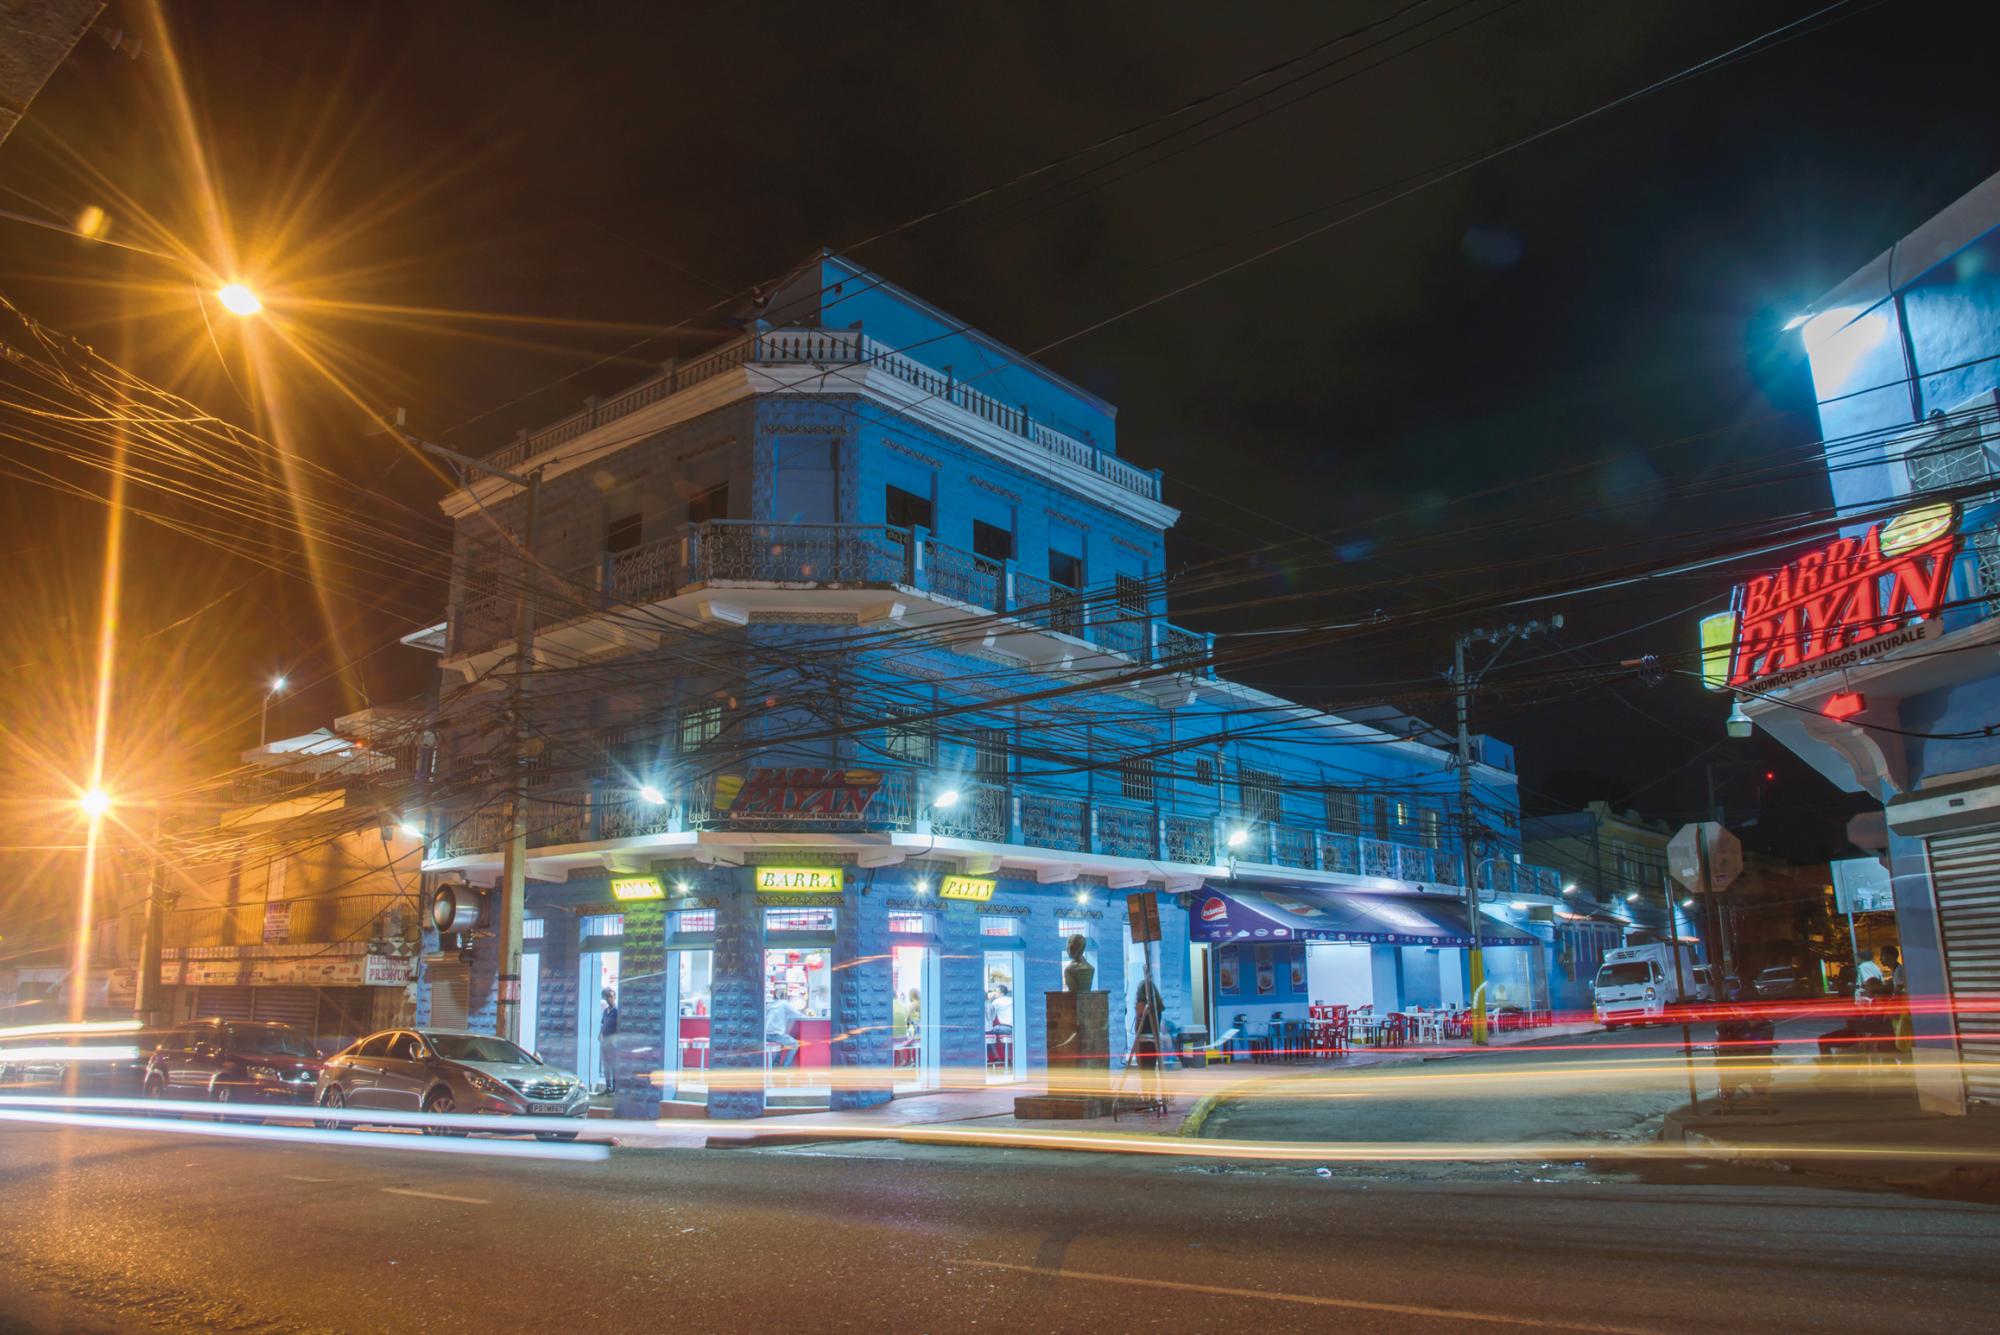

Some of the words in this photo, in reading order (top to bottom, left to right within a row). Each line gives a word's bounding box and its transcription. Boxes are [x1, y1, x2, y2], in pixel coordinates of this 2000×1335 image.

[1744, 525, 1882, 617] BARRA
[1731, 546, 1950, 686] PAYAN
[1809, 664, 1817, 675] Y
[1819, 651, 1857, 672] JUGOS
[1860, 627, 1926, 658] NATURALE
[736, 785, 880, 813] PAYAN
[763, 872, 837, 888] BARRA
[945, 880, 994, 897] PAYAN
